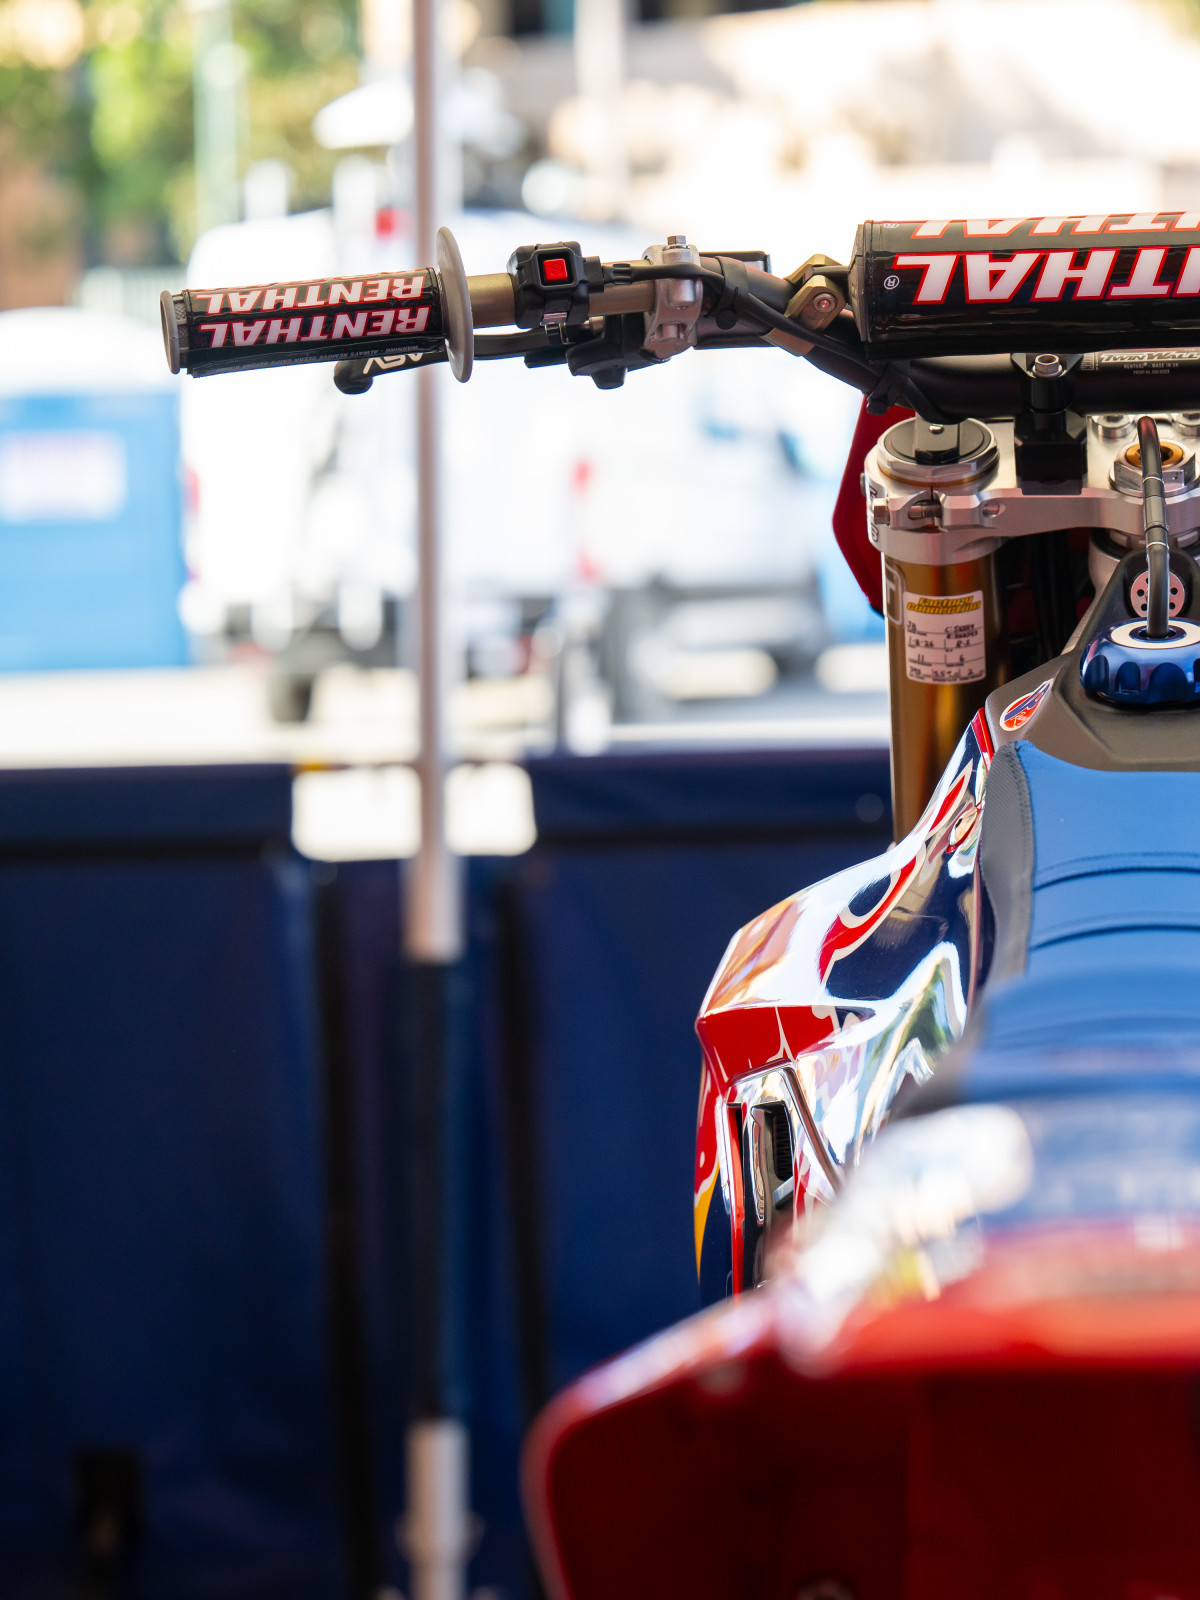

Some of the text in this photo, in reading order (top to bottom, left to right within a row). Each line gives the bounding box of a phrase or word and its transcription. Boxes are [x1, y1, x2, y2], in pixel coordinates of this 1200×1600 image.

[197, 275, 426, 316] RENTHAL
[200, 305, 431, 348] RENTHAL
[350, 349, 379, 357] ALWAYS
